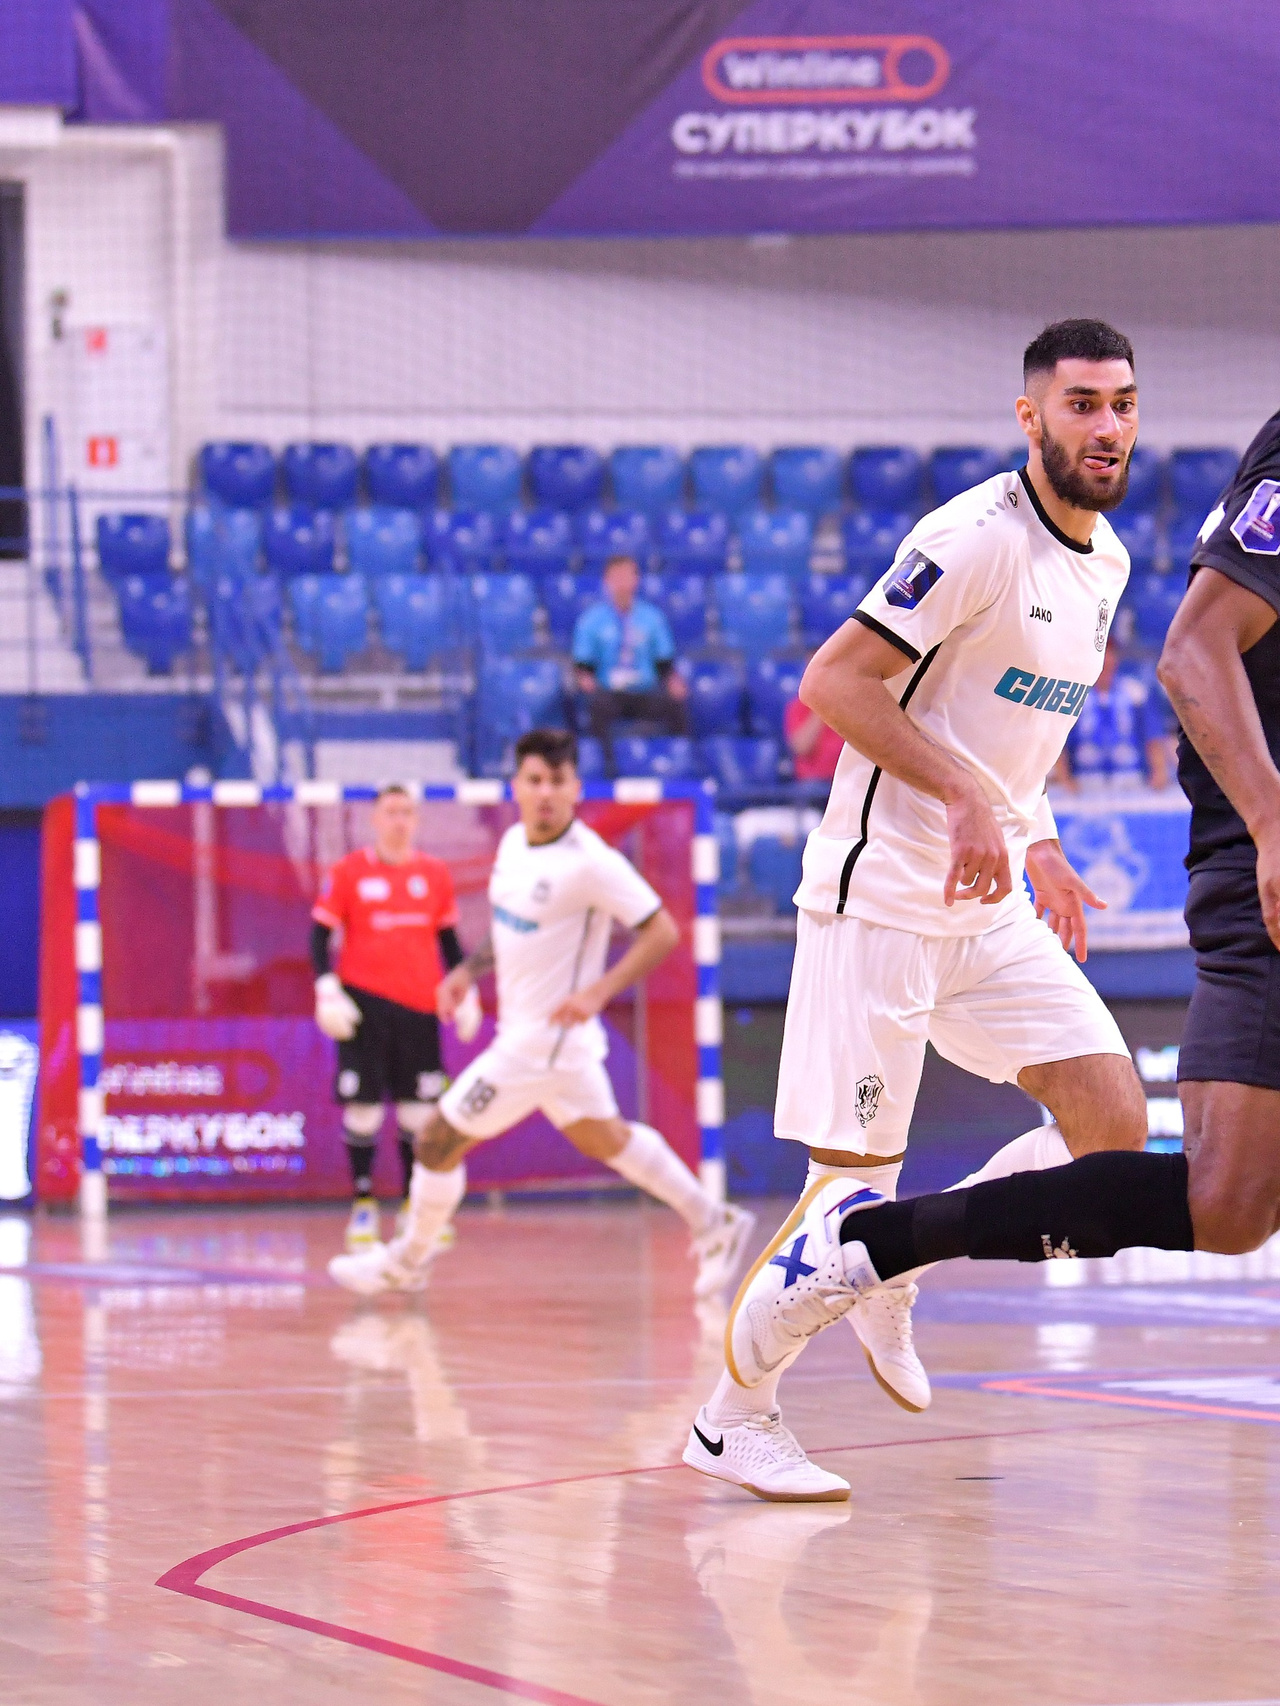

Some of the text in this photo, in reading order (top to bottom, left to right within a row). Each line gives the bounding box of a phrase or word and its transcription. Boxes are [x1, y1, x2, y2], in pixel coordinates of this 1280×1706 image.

[672, 108, 977, 154] СУПЕРКУБОК
[1029, 605, 1052, 623] JAKO
[97, 1112, 306, 1152] ПЕРКУБОК
